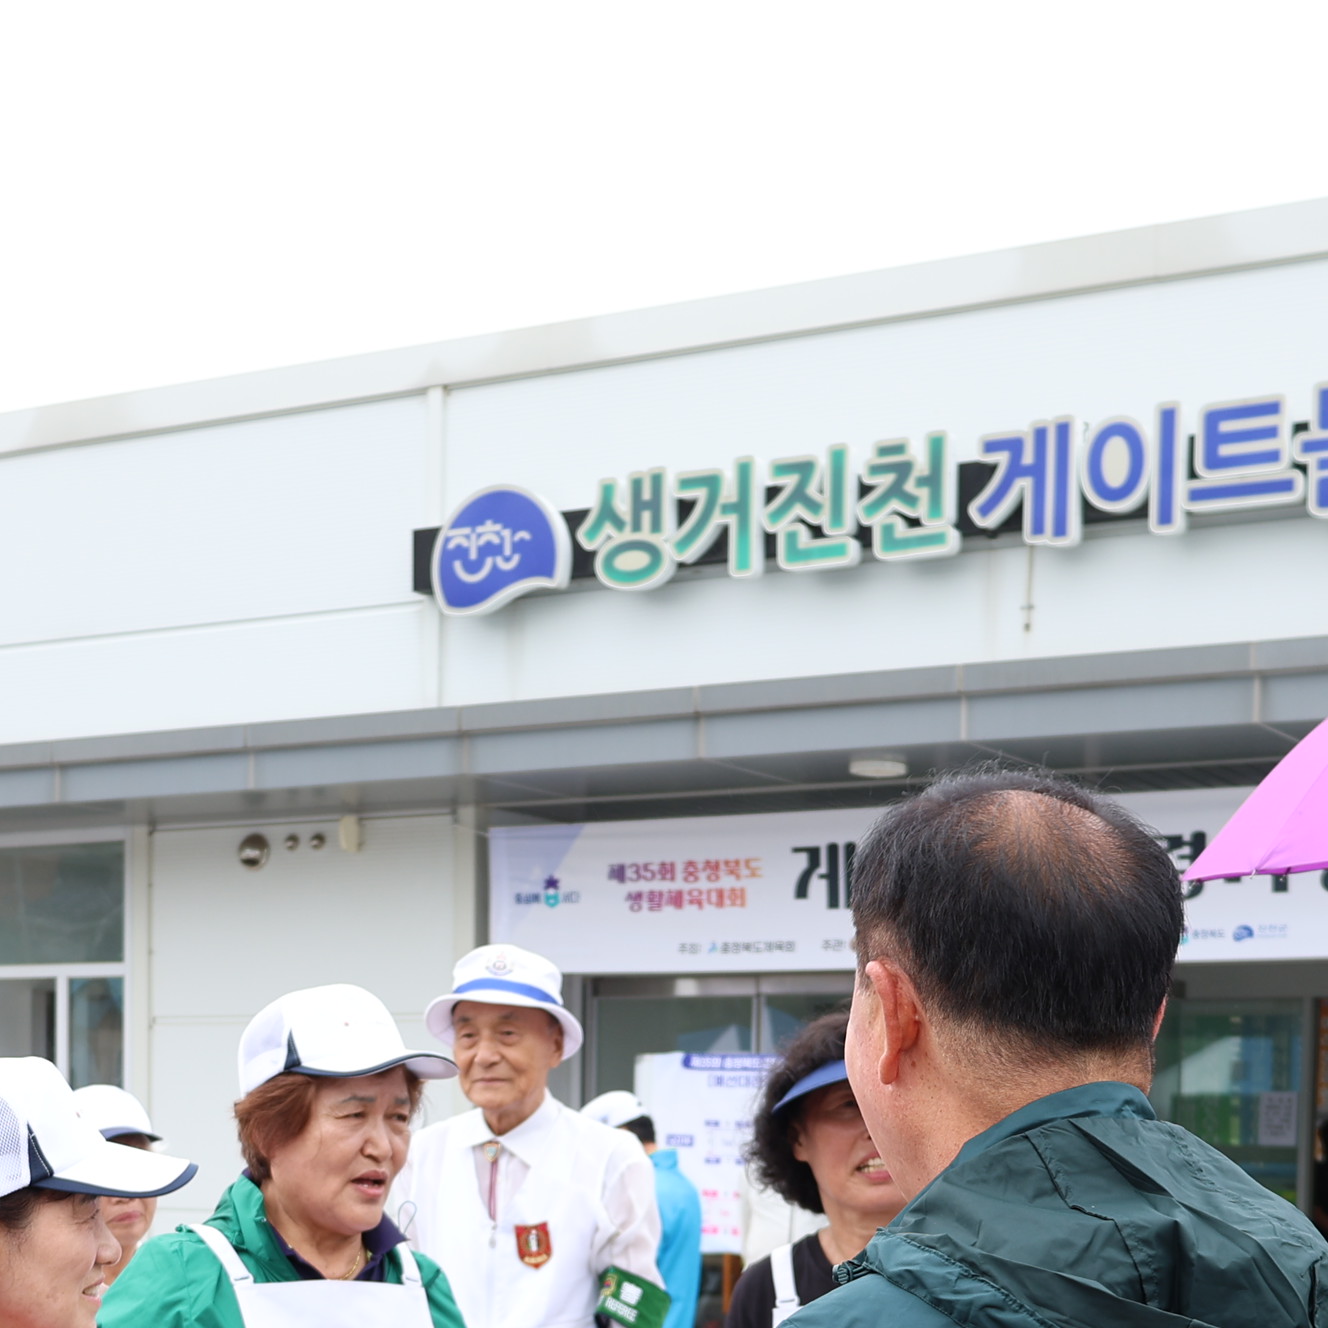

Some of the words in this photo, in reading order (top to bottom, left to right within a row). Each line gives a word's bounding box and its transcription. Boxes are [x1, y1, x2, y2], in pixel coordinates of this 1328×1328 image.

[578, 431, 954, 588] 생거진천
[607, 859, 677, 884] 제35회
[683, 857, 765, 883] 충청북도
[625, 886, 747, 913] 생활체육대회
